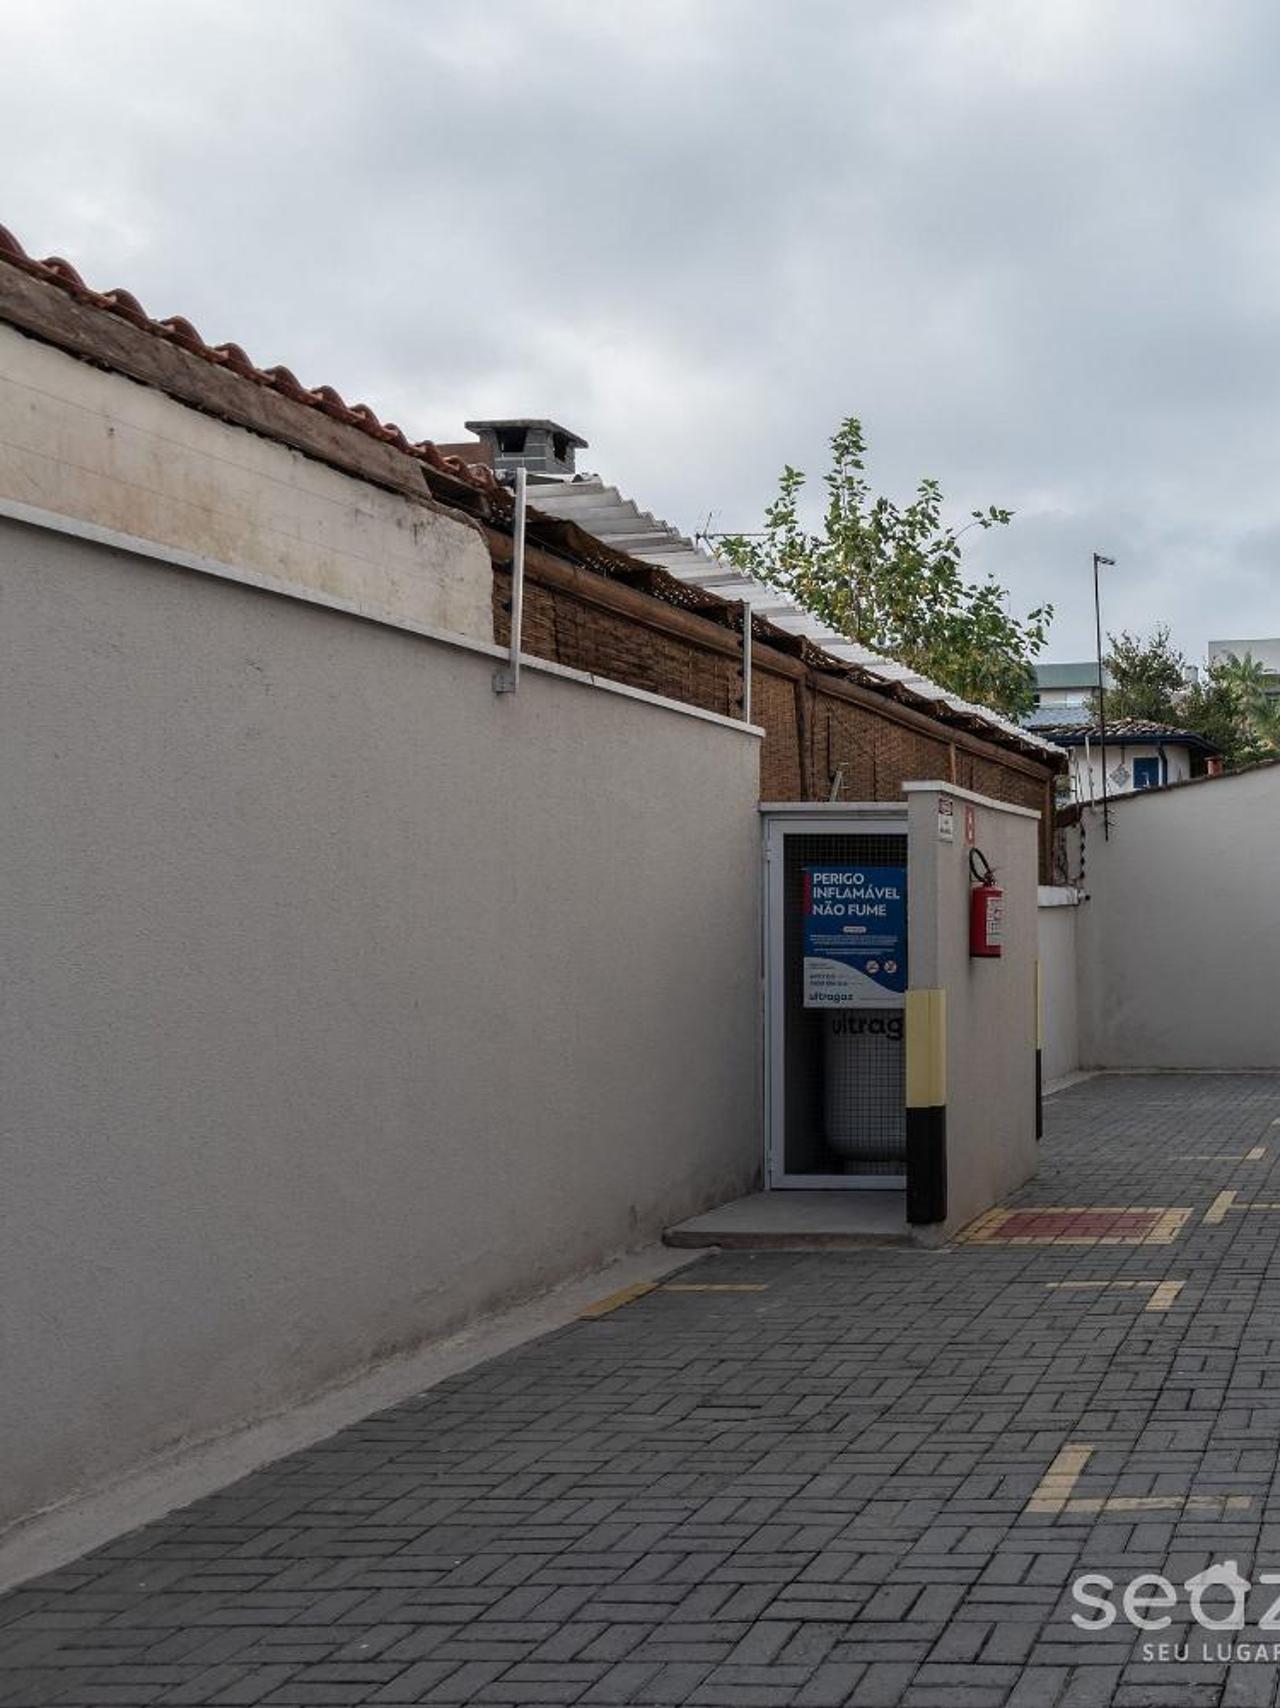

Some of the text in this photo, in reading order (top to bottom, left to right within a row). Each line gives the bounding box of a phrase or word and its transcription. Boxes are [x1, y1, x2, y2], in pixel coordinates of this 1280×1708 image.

[813, 873, 864, 885] PERIGO
[813, 884, 900, 899] INFLAMÁVEL
[812, 900, 887, 916] NÃO FUME
[808, 991, 854, 1003] ultragaz
